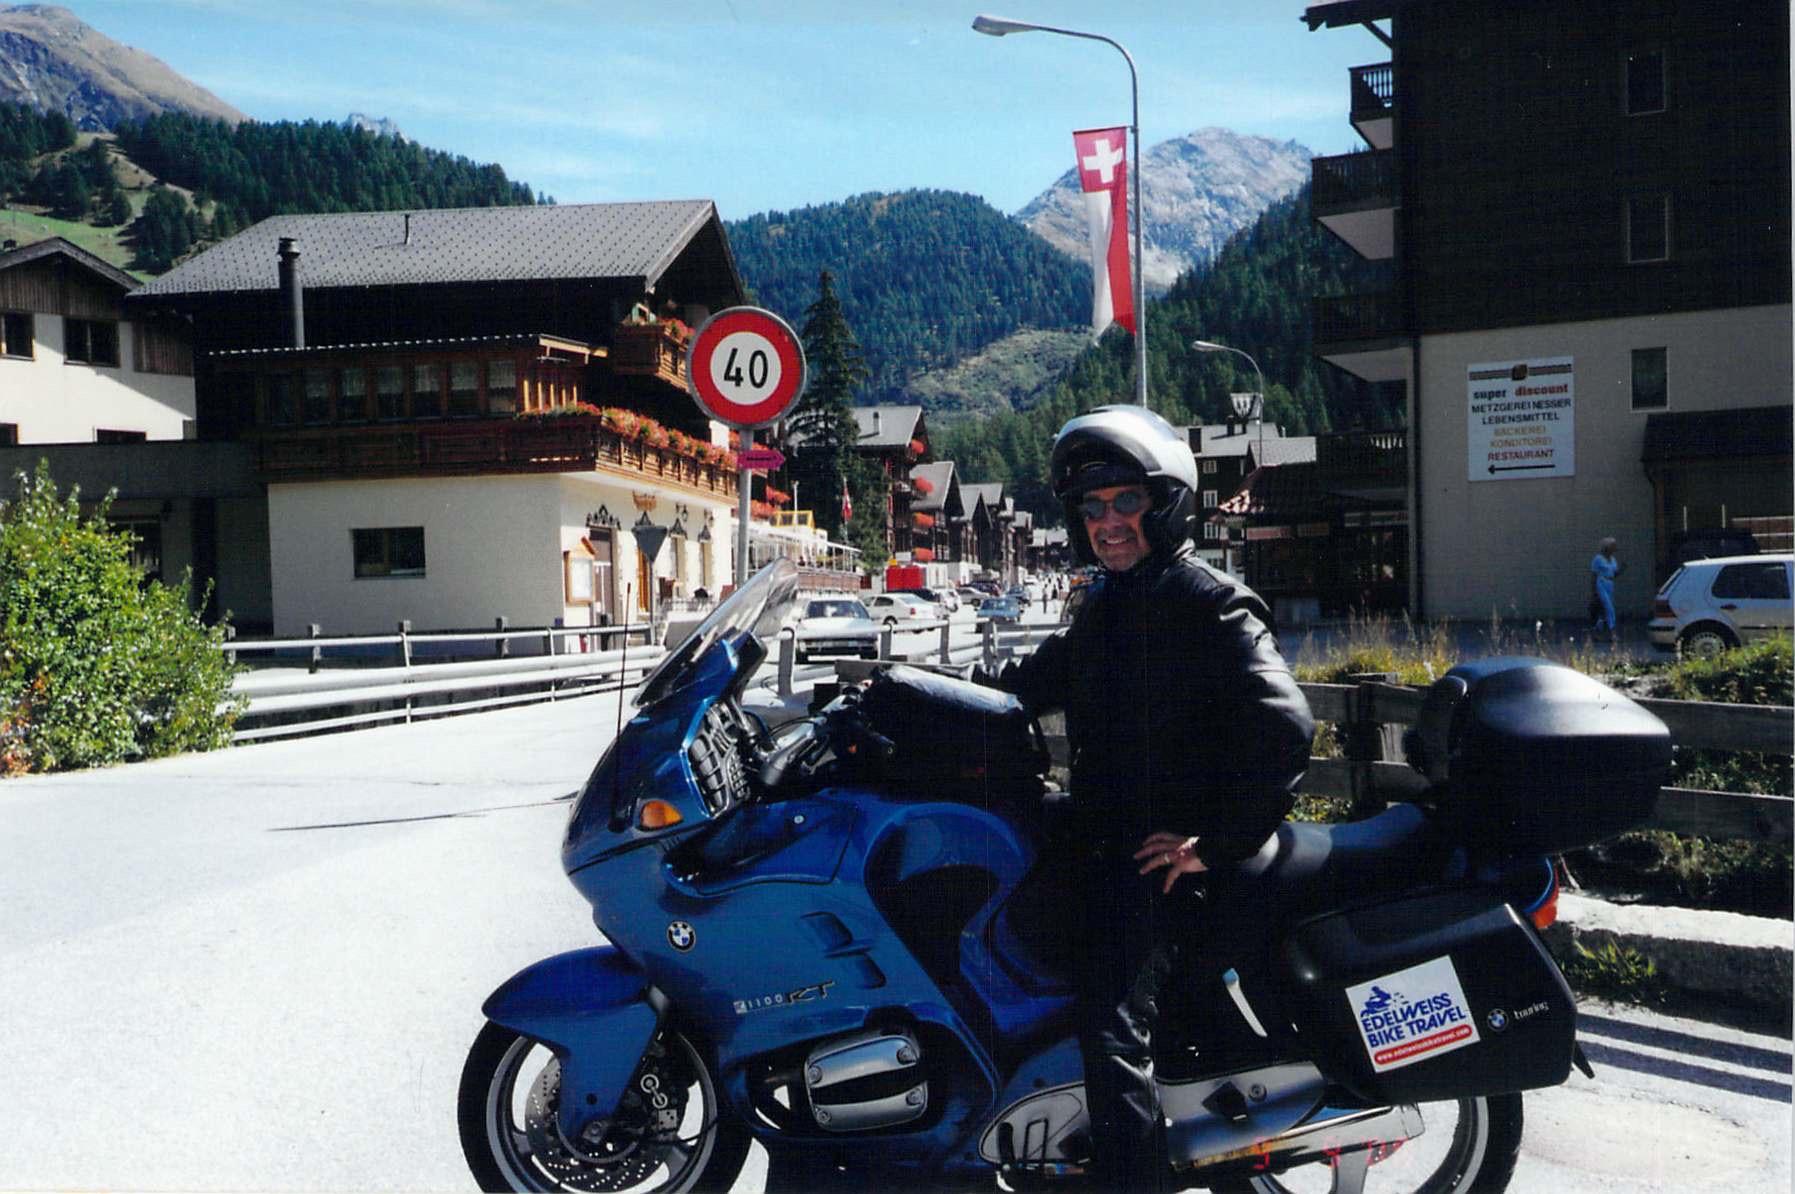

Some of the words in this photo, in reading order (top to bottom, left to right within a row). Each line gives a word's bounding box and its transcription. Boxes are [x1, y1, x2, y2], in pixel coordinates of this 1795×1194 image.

[724, 347, 769, 389] 40
[1473, 389, 1507, 400] super
[1514, 384, 1569, 397] discount
[1481, 412, 1560, 425] LEBENSMITTEL
[749, 994, 783, 1008] 1100
[1361, 993, 1452, 1032] EDELWEISS
[1367, 1026, 1407, 1048] BIKE
[1407, 1006, 1466, 1035] TRAVEL
